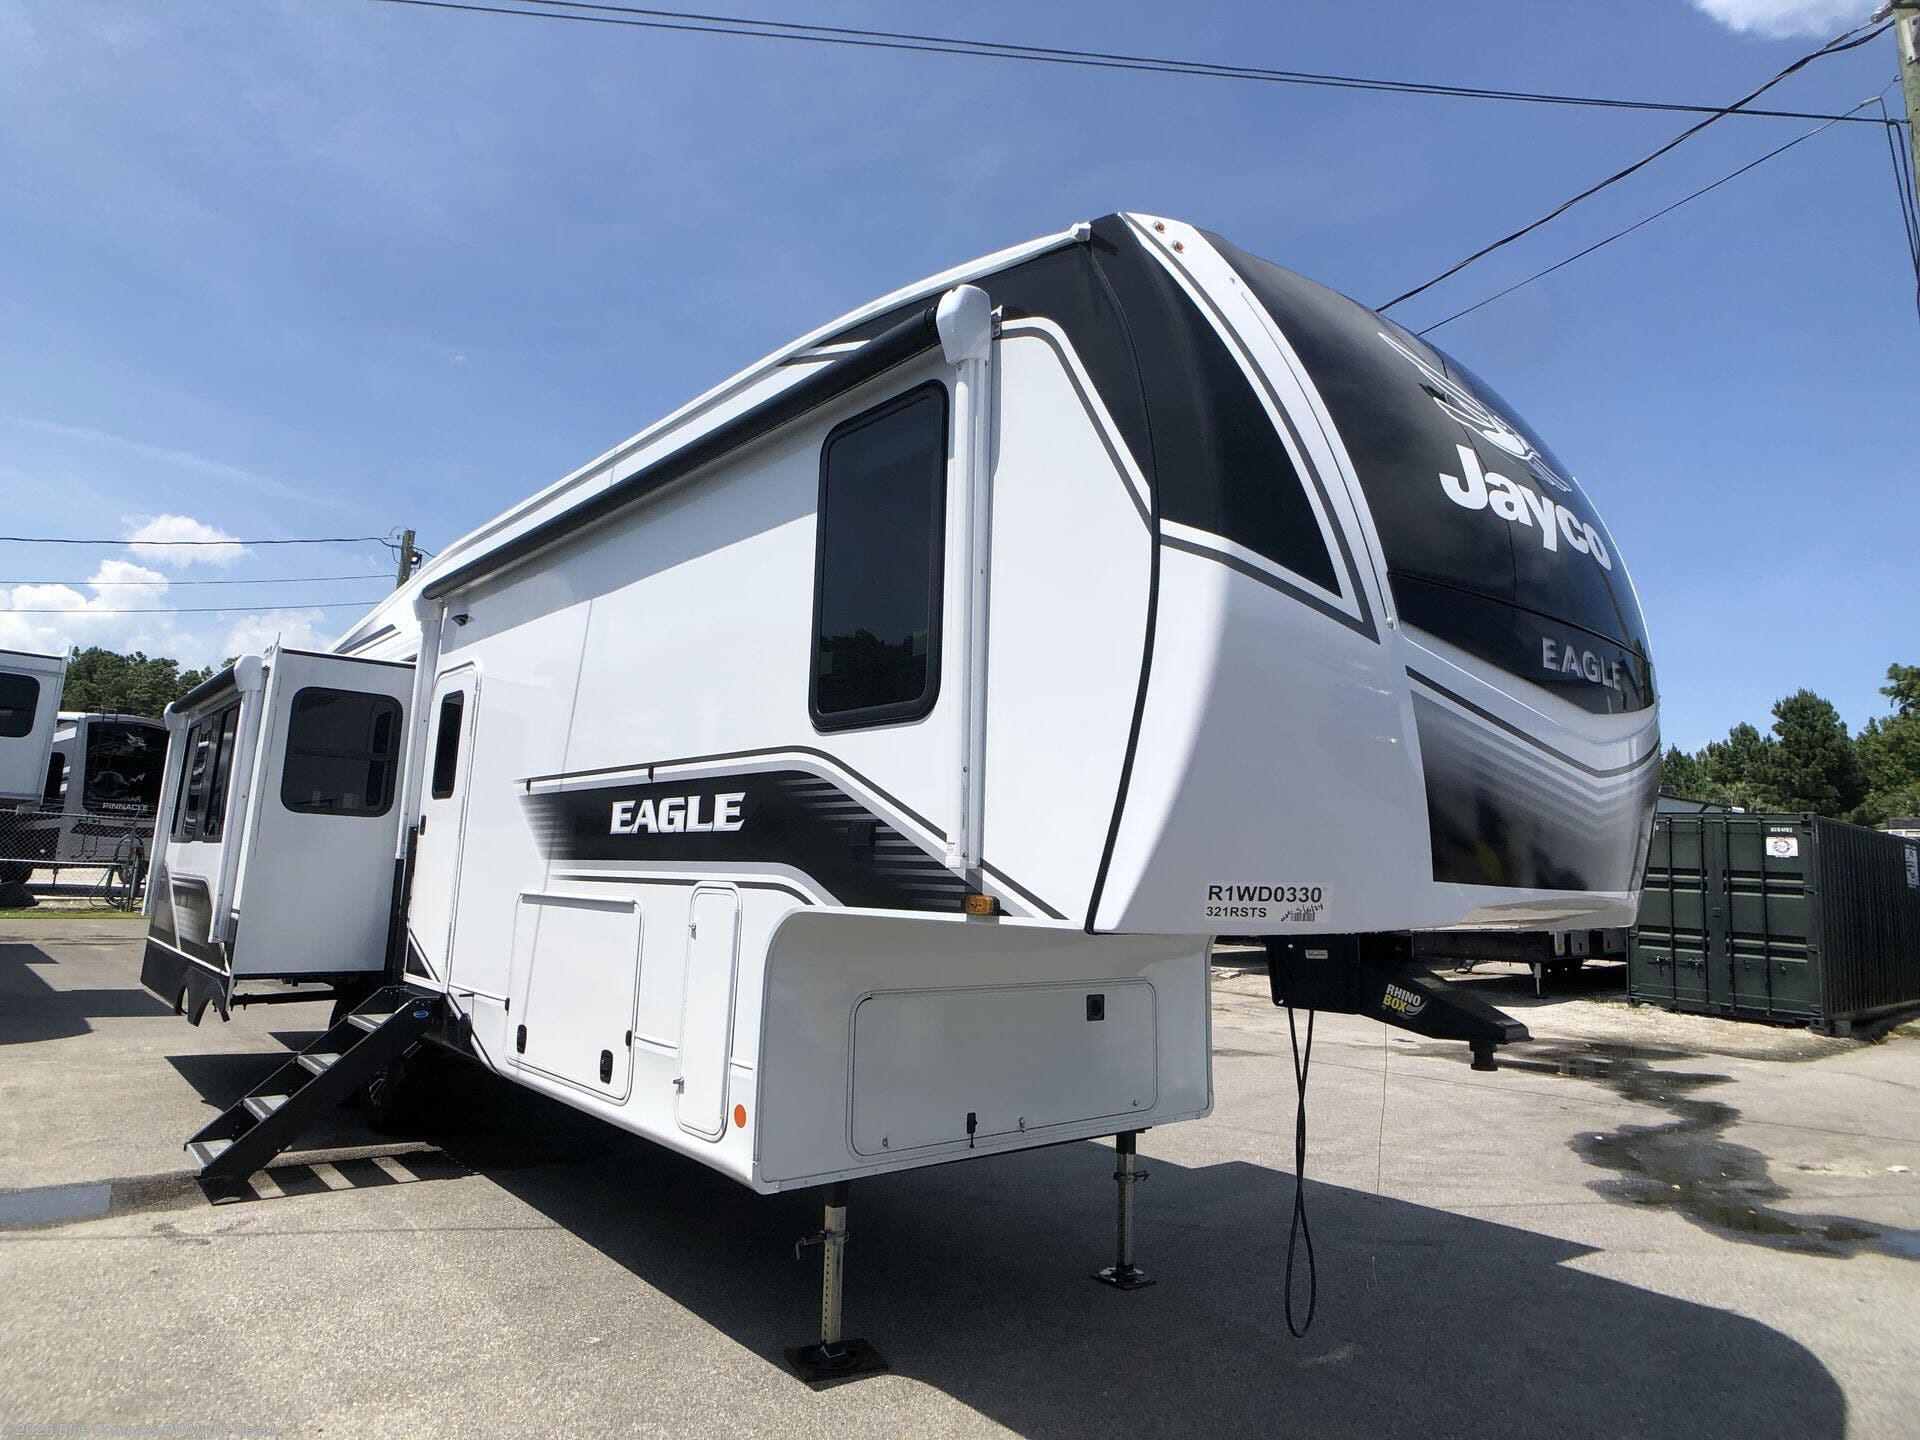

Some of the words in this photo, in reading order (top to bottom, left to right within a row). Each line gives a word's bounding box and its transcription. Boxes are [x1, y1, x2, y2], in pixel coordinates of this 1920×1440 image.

[1439, 443, 1612, 571] Jayco
[1542, 637, 1623, 691] EAGLE
[102, 802, 149, 811] PINNACLE
[610, 792, 746, 834] EAGLE
[1208, 885, 1322, 903] R1WD0330
[1206, 906, 1267, 918] 321RSTS
[1383, 994, 1408, 1013] BOX
[1386, 983, 1421, 1006] RHINO
